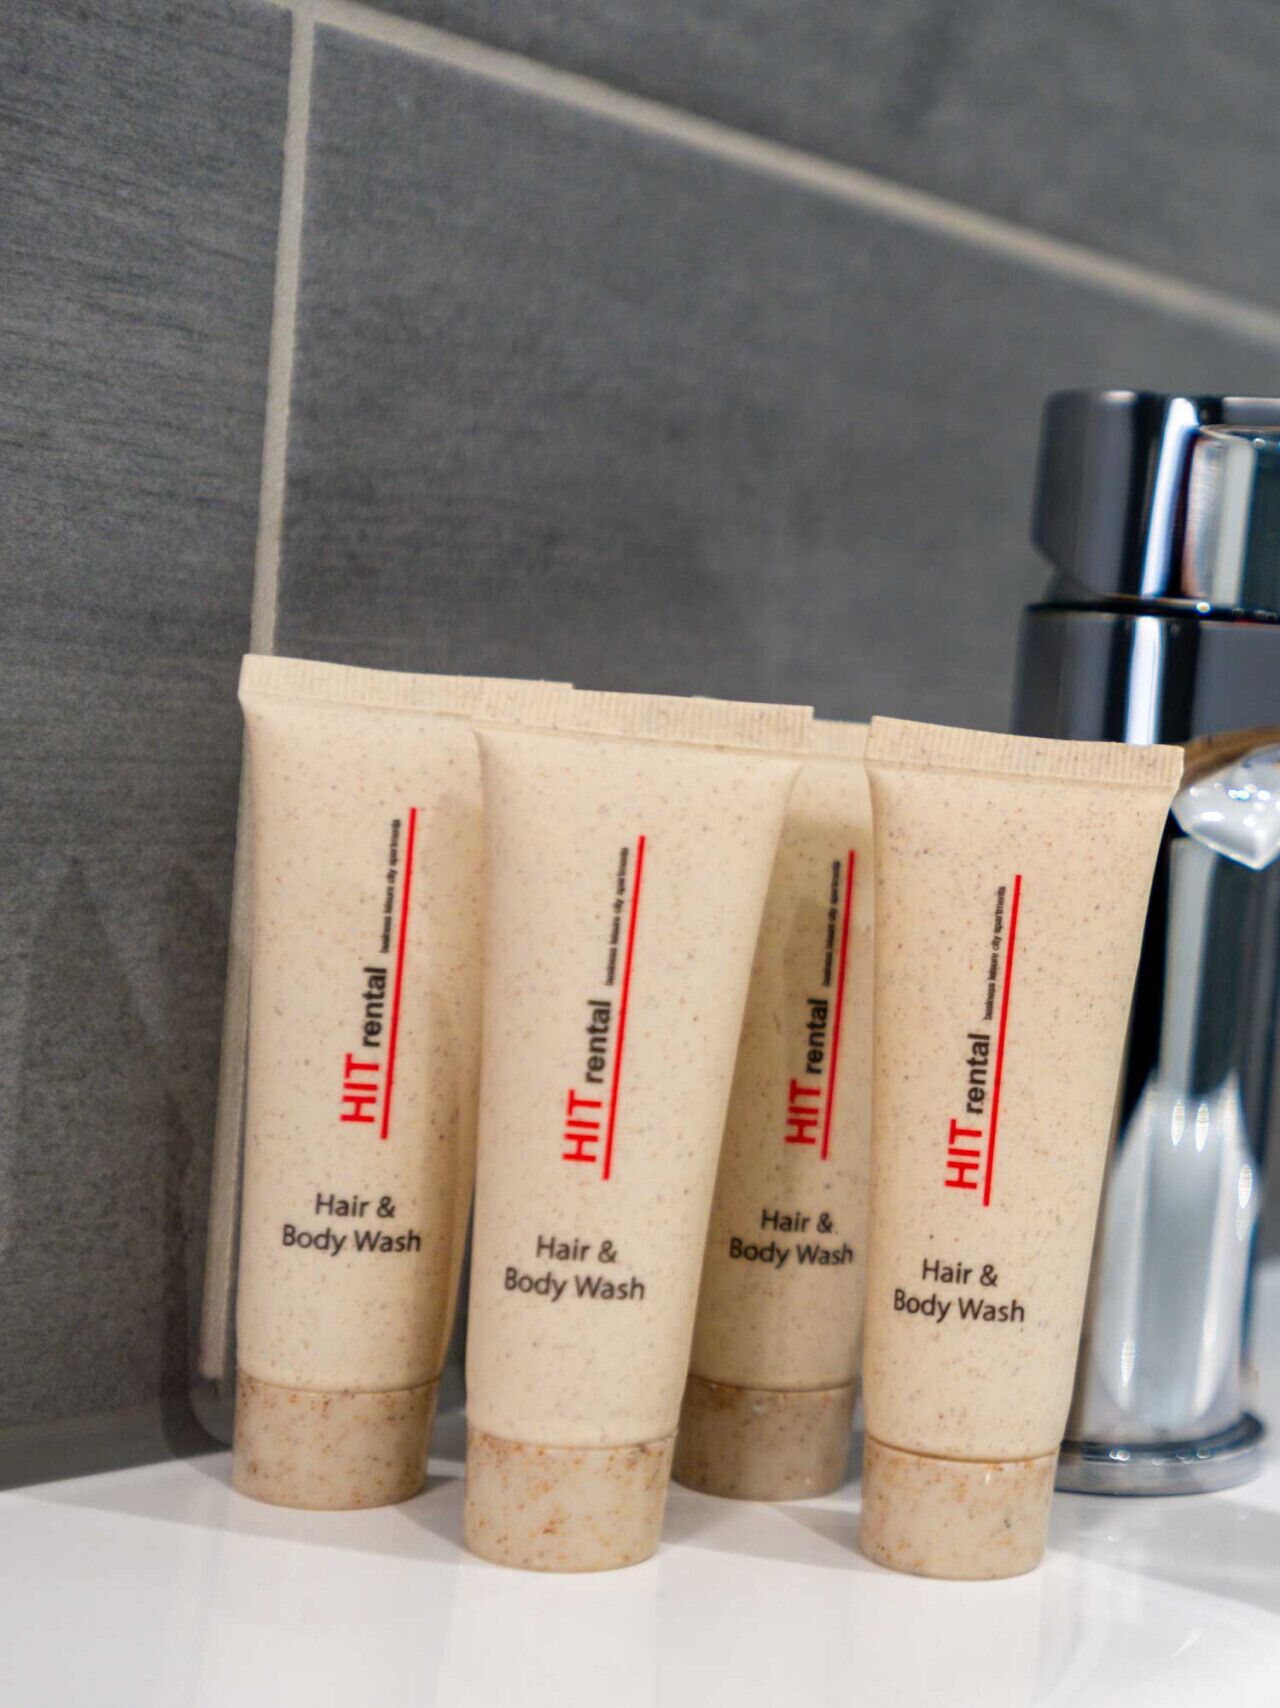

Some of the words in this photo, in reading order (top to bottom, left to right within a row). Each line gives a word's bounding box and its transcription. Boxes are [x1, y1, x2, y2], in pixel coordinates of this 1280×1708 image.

[359, 966, 387, 1048] rental
[340, 1053, 380, 1123] HIT
[561, 1089, 603, 1164] HIT
[584, 1000, 612, 1084] rental
[784, 1079, 821, 1146] HIT
[804, 999, 828, 1075] rental
[944, 1119, 982, 1190] HIT
[965, 1034, 990, 1114] rental
[315, 1192, 370, 1218] Hair
[376, 1195, 397, 1219] &
[760, 1209, 811, 1233] Hair
[816, 1212, 834, 1234] &
[281, 1224, 347, 1257] Body
[354, 1229, 422, 1253] Wash
[535, 1235, 591, 1262] Hair
[597, 1240, 619, 1264] &
[729, 1237, 789, 1269] Body
[796, 1244, 854, 1265] Wash
[504, 1267, 568, 1302] Body
[574, 1276, 646, 1301] Wash
[921, 1258, 973, 1285] Hair
[979, 1264, 998, 1287] &
[893, 1288, 951, 1324] Body
[957, 1298, 1026, 1323] Wash
